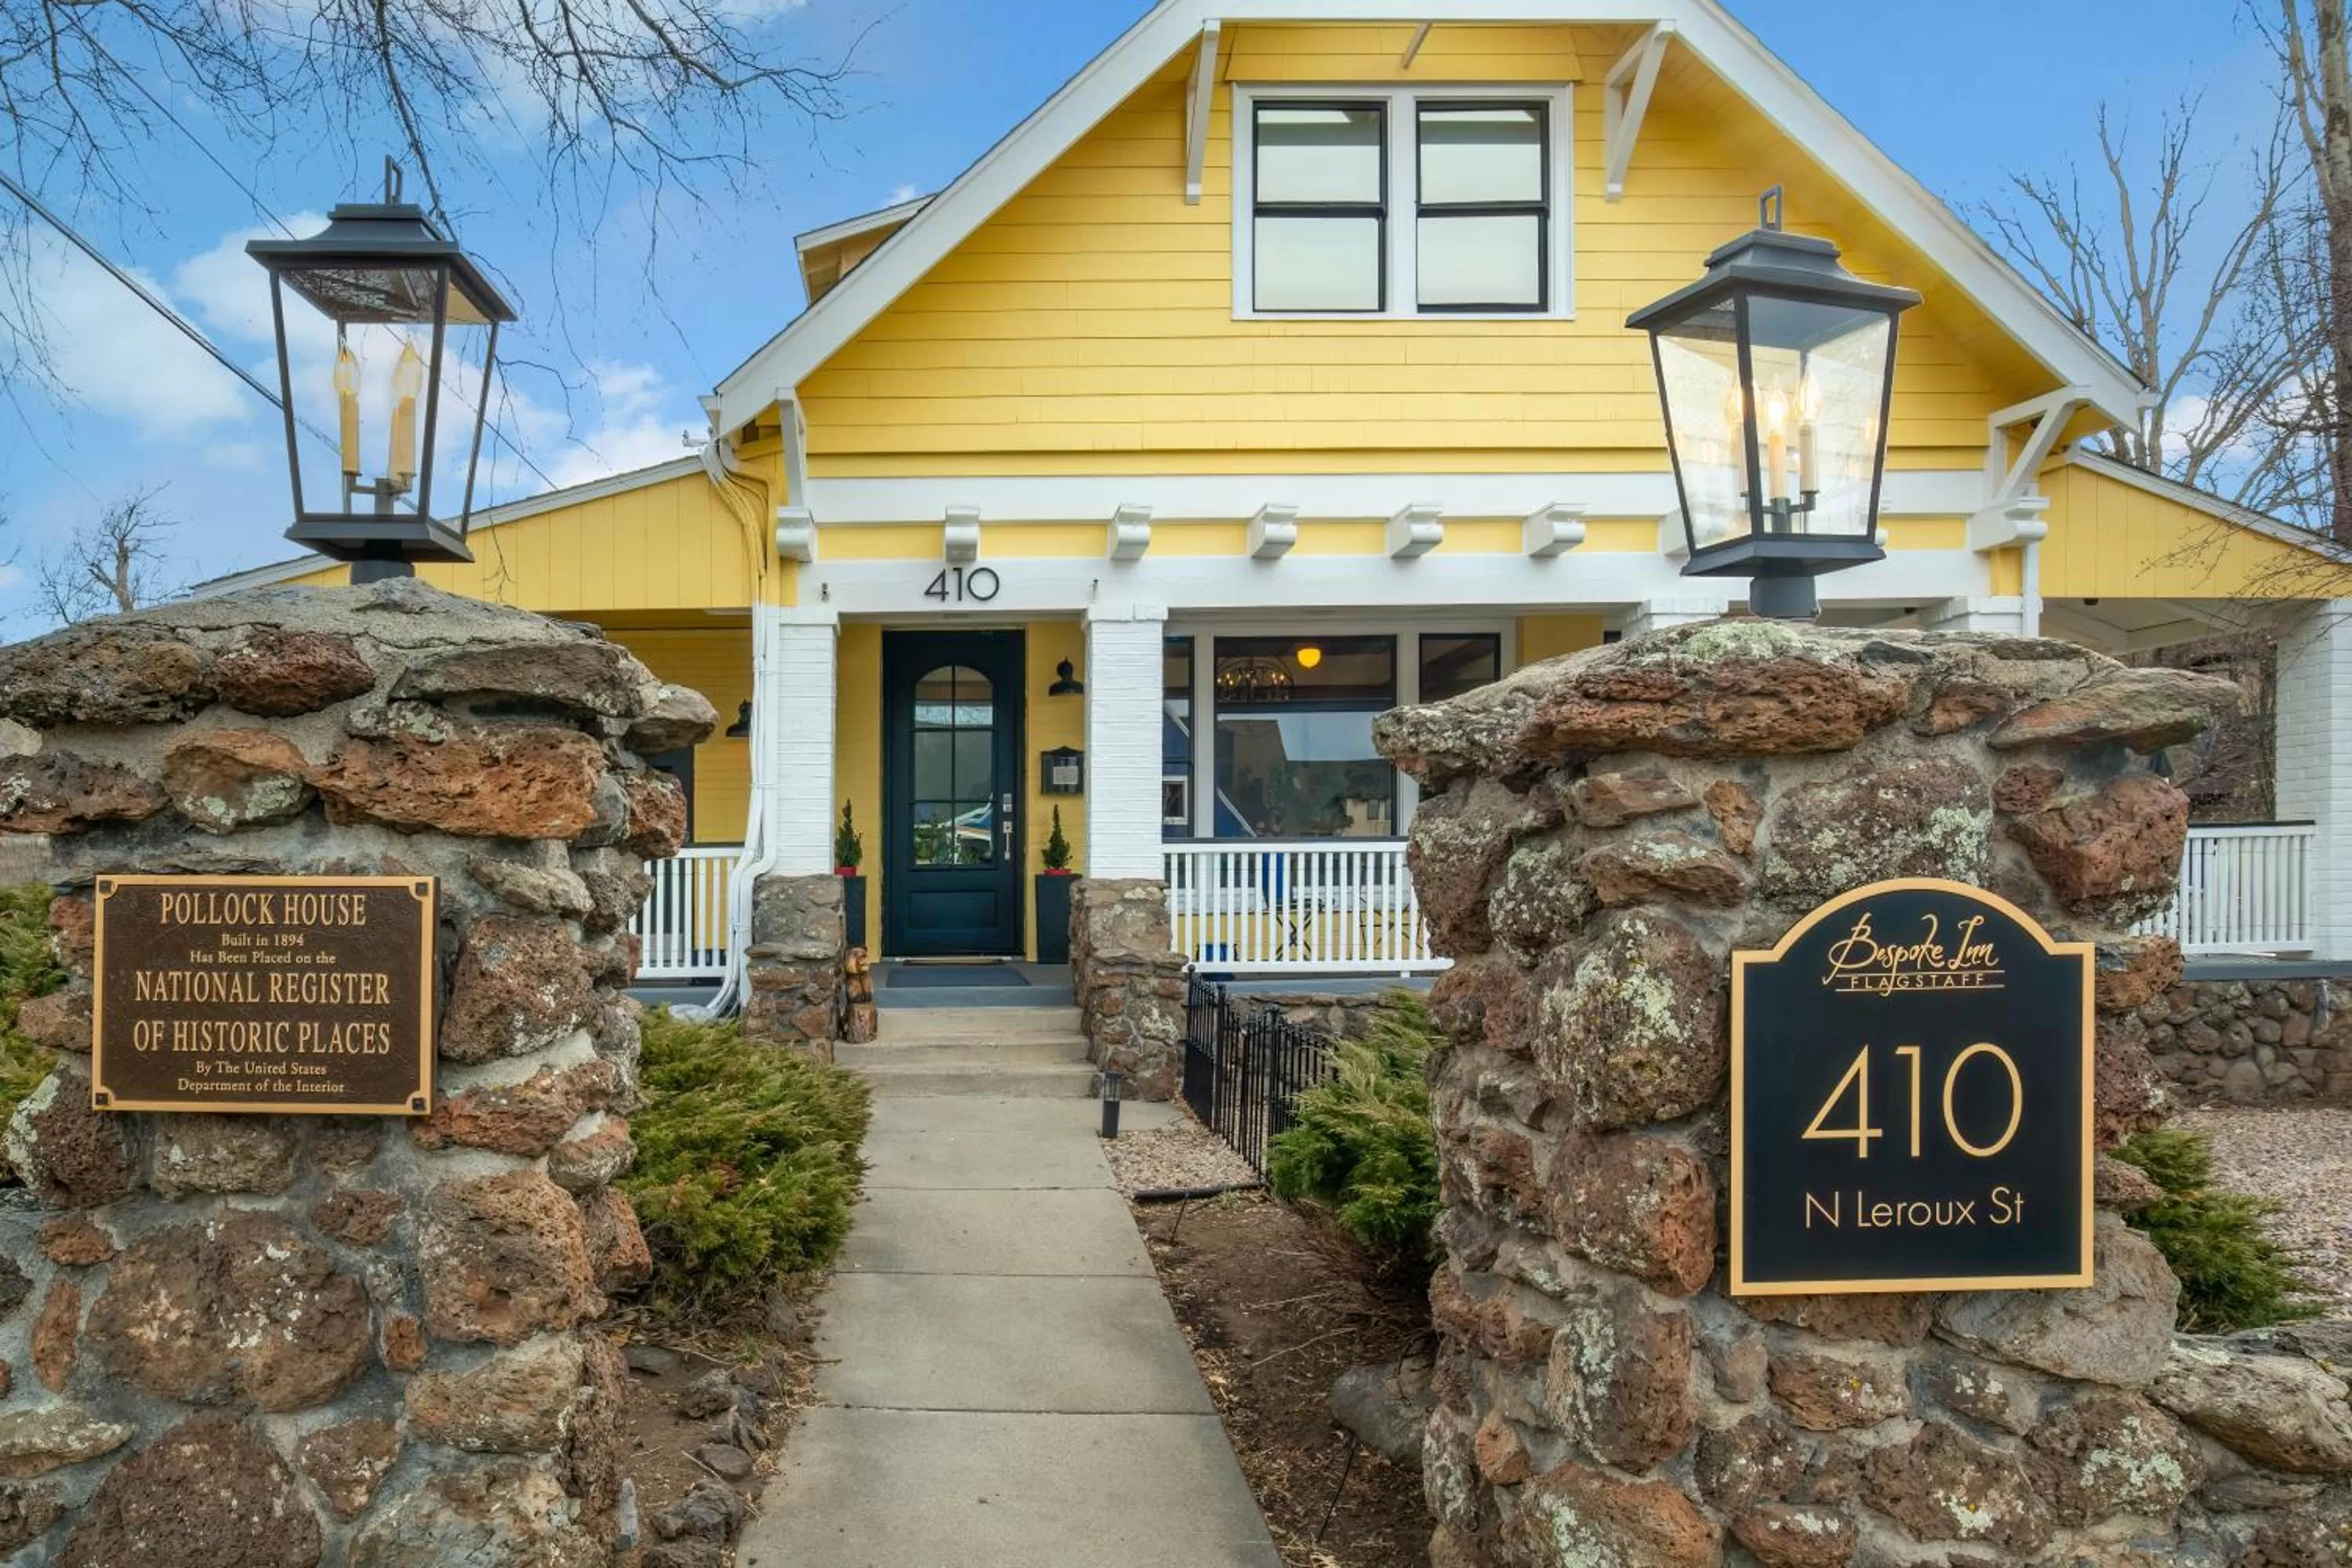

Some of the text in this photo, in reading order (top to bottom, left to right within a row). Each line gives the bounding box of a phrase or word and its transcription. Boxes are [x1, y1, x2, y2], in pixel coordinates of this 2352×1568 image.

[924, 566, 1000, 602] 410
[161, 893, 366, 926] POLLOCK HOUSE
[221, 933, 304, 947] Built in 1894
[1821, 913, 1998, 996] Bespoke Inn
[190, 952, 336, 965] Has Been Placed on the
[134, 971, 390, 1005] NATIONAL REGISTER
[1851, 973, 1985, 989] FLAGSTAFF
[133, 1020, 390, 1054] OF HISTORIC PLACES
[196, 1062, 327, 1076] By The United States
[178, 1079, 344, 1093] Department of the Interior
[1802, 1042, 2022, 1158] 410
[1806, 1186, 2024, 1228] N Leroux St
